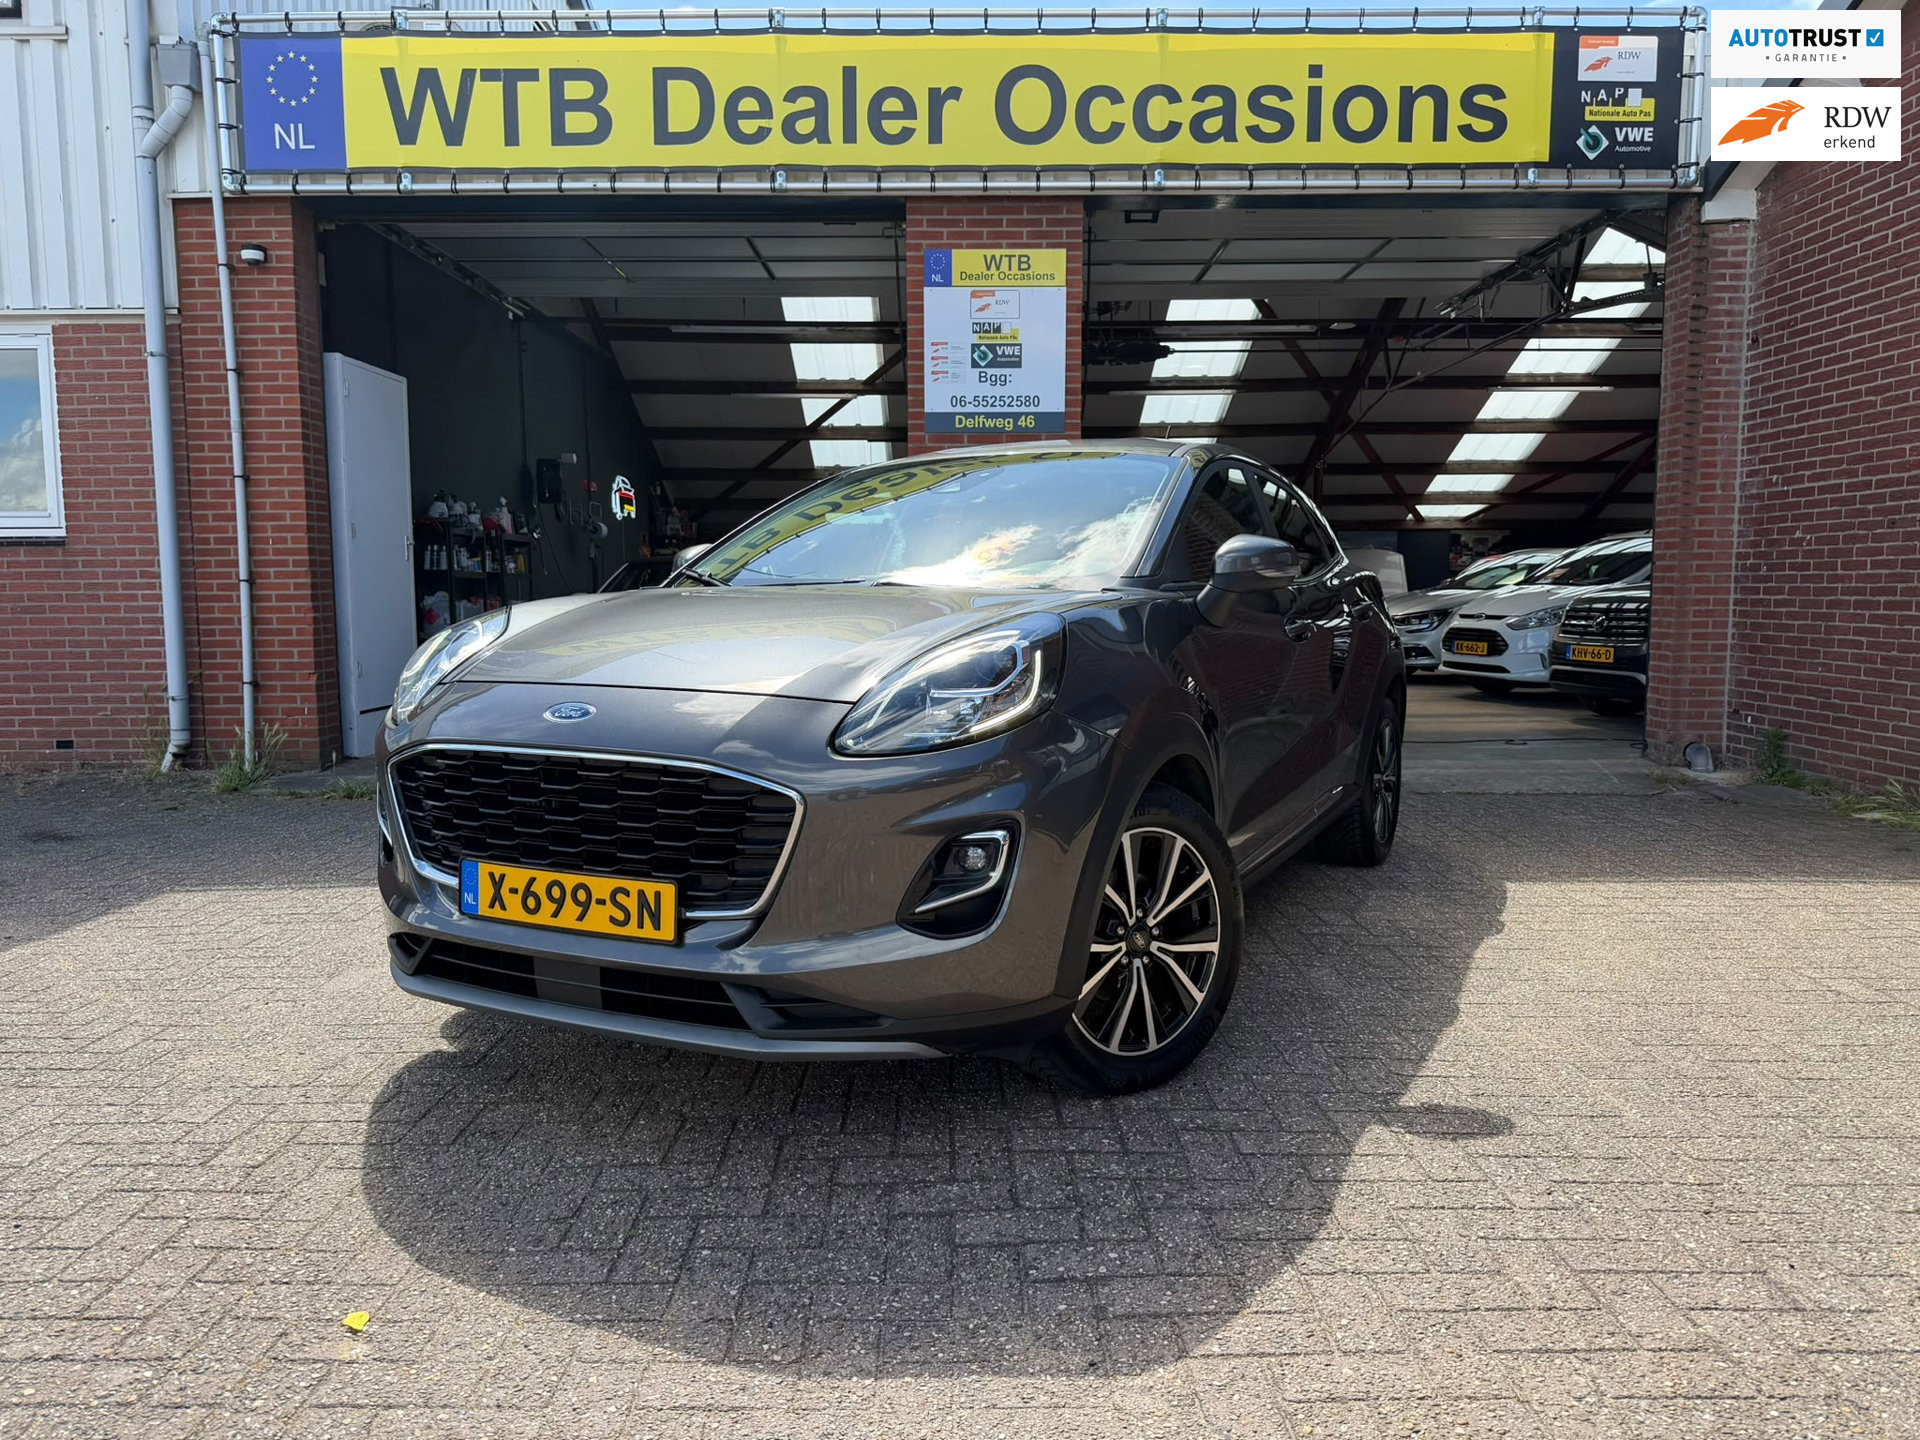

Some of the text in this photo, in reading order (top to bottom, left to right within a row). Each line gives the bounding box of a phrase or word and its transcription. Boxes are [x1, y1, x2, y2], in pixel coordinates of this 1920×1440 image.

[1617, 51, 1641, 60] RDW
[380, 64, 1508, 147] WTB Dealer Occasions
[1589, 109, 1651, 117] Nationale Auto Pas
[274, 123, 315, 150] NL
[1615, 127, 1653, 142] VWE
[1615, 145, 1651, 153] Automotive
[983, 254, 1031, 272] WTB
[931, 274, 944, 283] NL
[960, 271, 1055, 281] Dealer Occasions
[996, 346, 1021, 355] VWE
[978, 371, 1012, 386] Bgg:
[951, 395, 1040, 408] 06-55252580
[955, 415, 1035, 431] Delfweg 46
[1571, 647, 1612, 660] KHV-66-D
[555, 706, 585, 717] Ford
[464, 892, 476, 905] NL
[488, 871, 661, 931] X-699-SN
